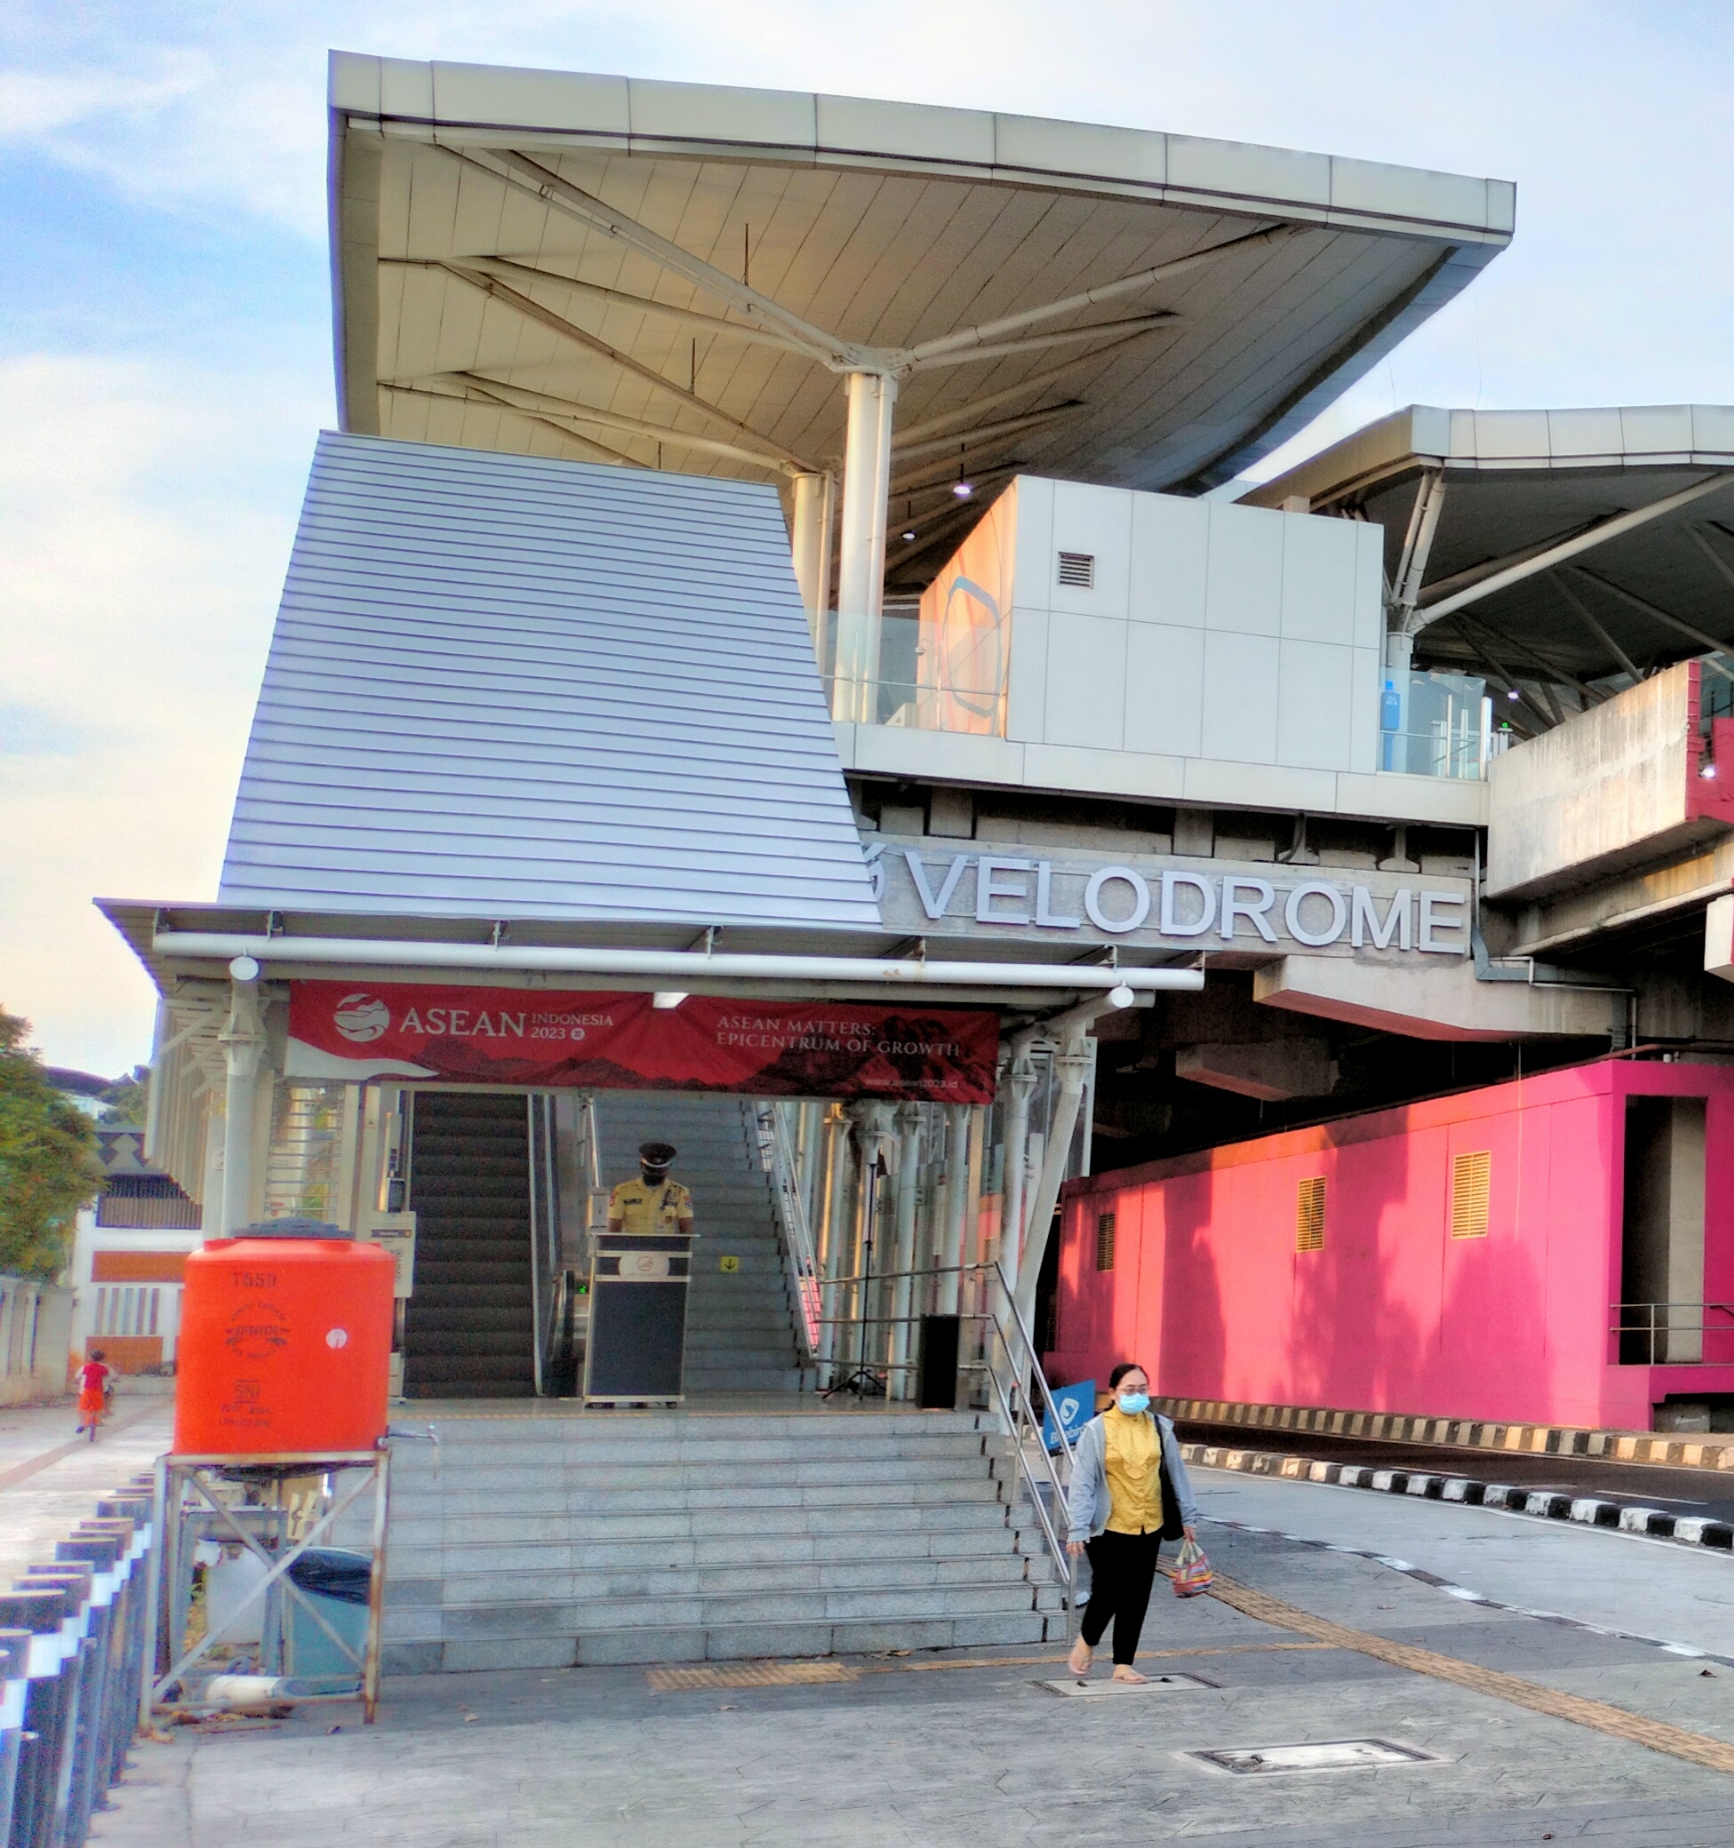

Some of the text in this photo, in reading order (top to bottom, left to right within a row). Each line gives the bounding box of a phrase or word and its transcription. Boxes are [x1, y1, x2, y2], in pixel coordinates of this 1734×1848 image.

[904, 850, 1466, 954] VELODROME
[400, 1006, 527, 1039] ASEAN
[531, 1013, 614, 1026] INDONESIA
[717, 1016, 876, 1036] ASEAN MATTERS:
[531, 1026, 566, 1039] 2023
[717, 1032, 960, 1057] EPICENTRUM OF GROWTH
